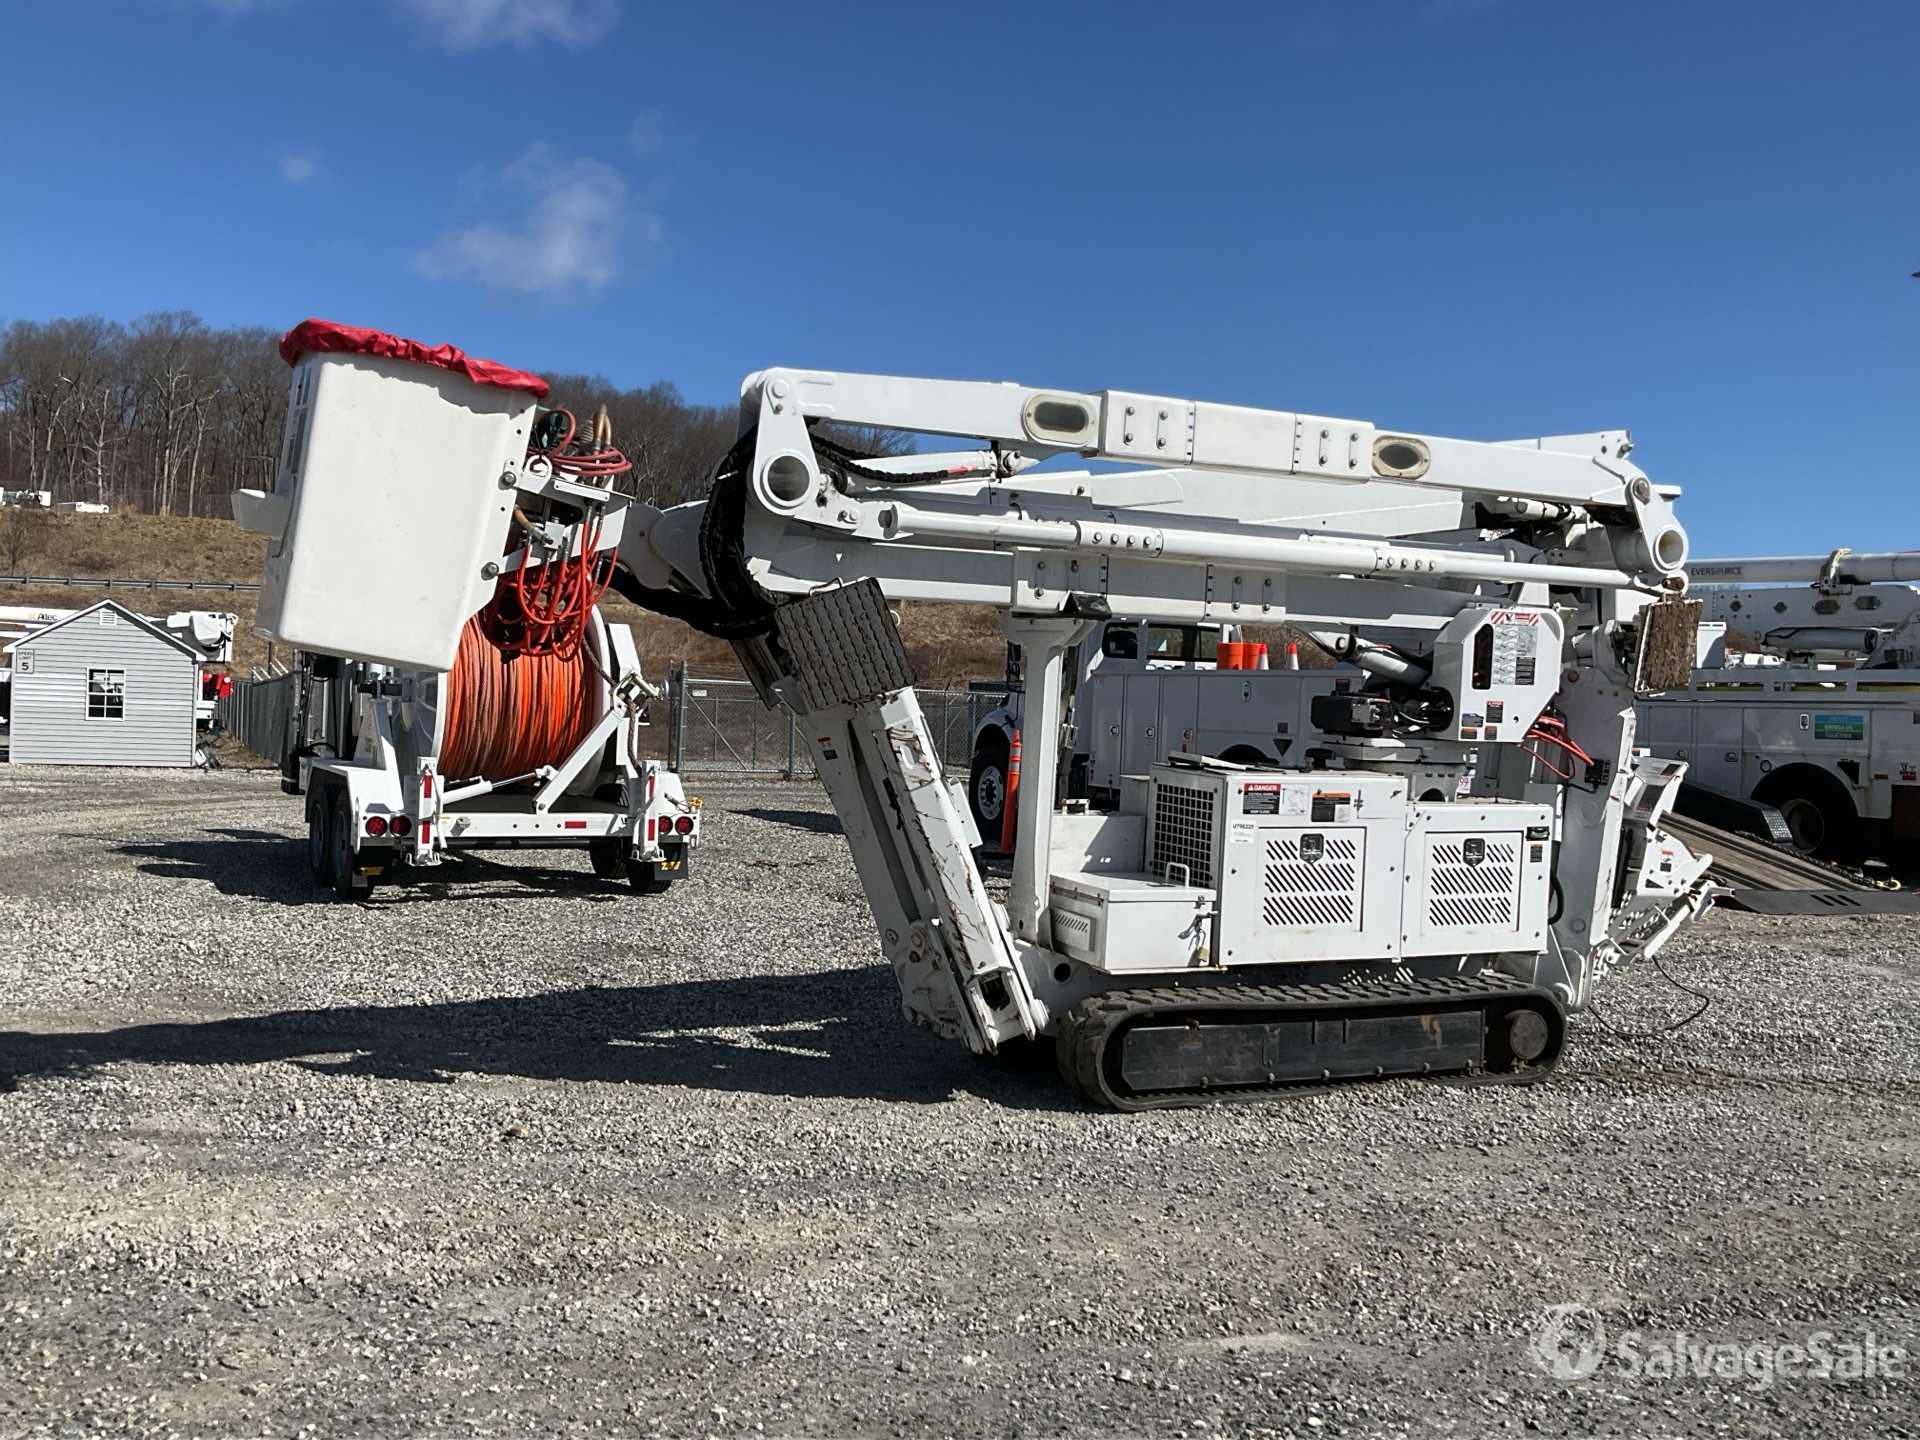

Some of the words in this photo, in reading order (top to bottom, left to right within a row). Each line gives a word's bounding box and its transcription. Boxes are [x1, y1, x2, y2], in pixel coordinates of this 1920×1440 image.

[1690, 566, 1743, 576] EVERSOURCE
[37, 612, 58, 621] Altec
[22, 662, 29, 670] 5
